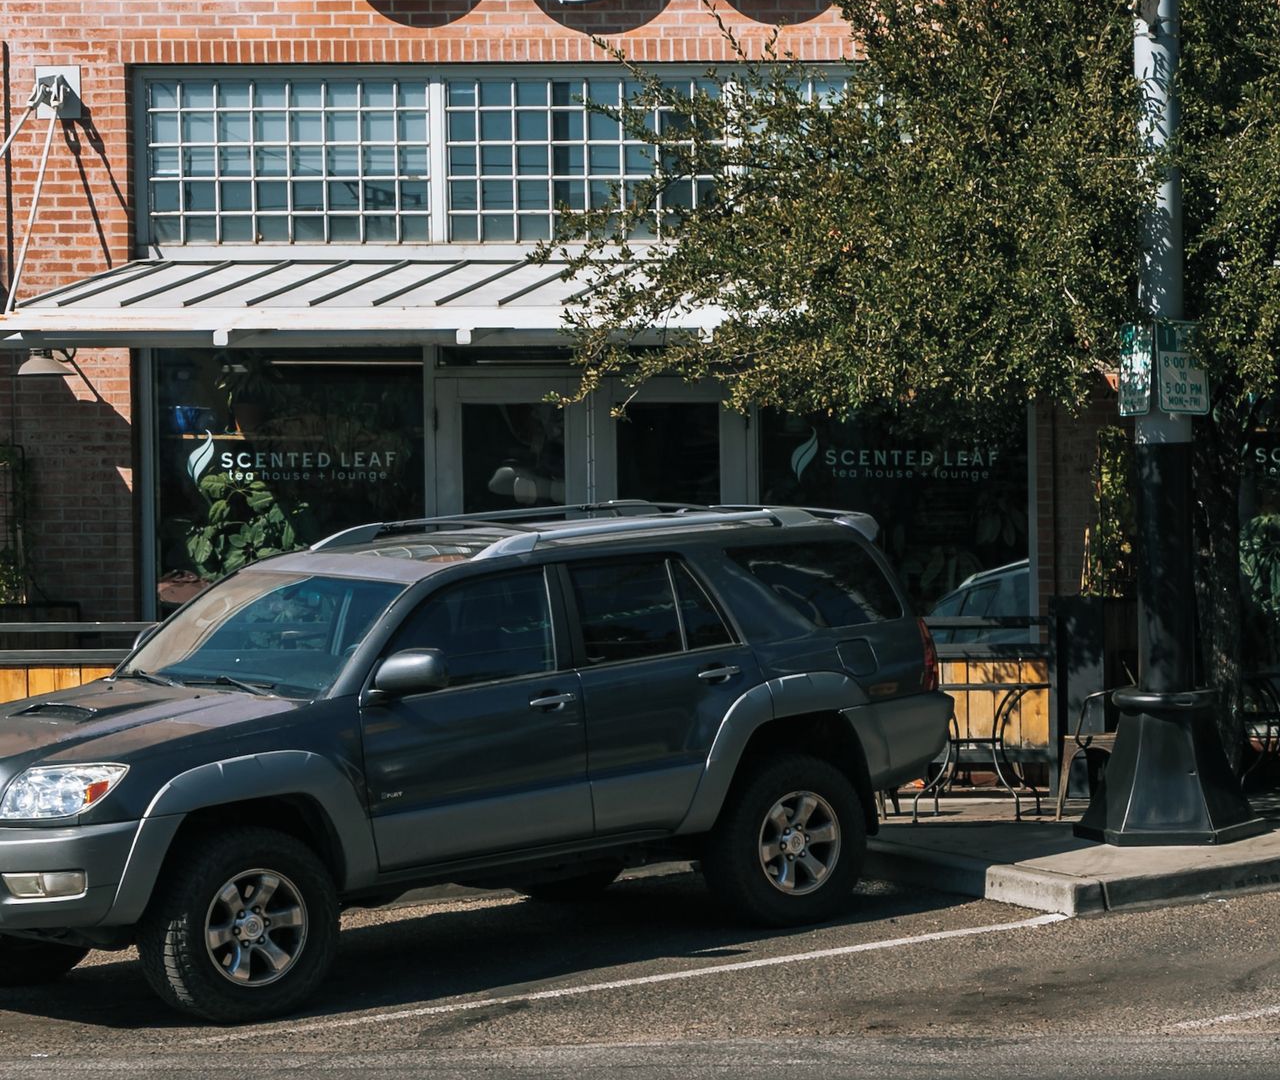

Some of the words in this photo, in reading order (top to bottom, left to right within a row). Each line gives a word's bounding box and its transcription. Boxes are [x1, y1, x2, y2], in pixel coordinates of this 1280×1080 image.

[1190, 384, 1202, 396] PM
[220, 451, 331, 469] SCENTED
[340, 451, 397, 468] LEAF
[825, 449, 934, 466] SCENTED
[943, 449, 1000, 466] LEAF
[228, 468, 255, 481] tea
[261, 469, 311, 481] house
[332, 469, 388, 483] lounge
[832, 467, 857, 479] tea
[866, 466, 914, 479] house
[935, 466, 990, 482] lounge
